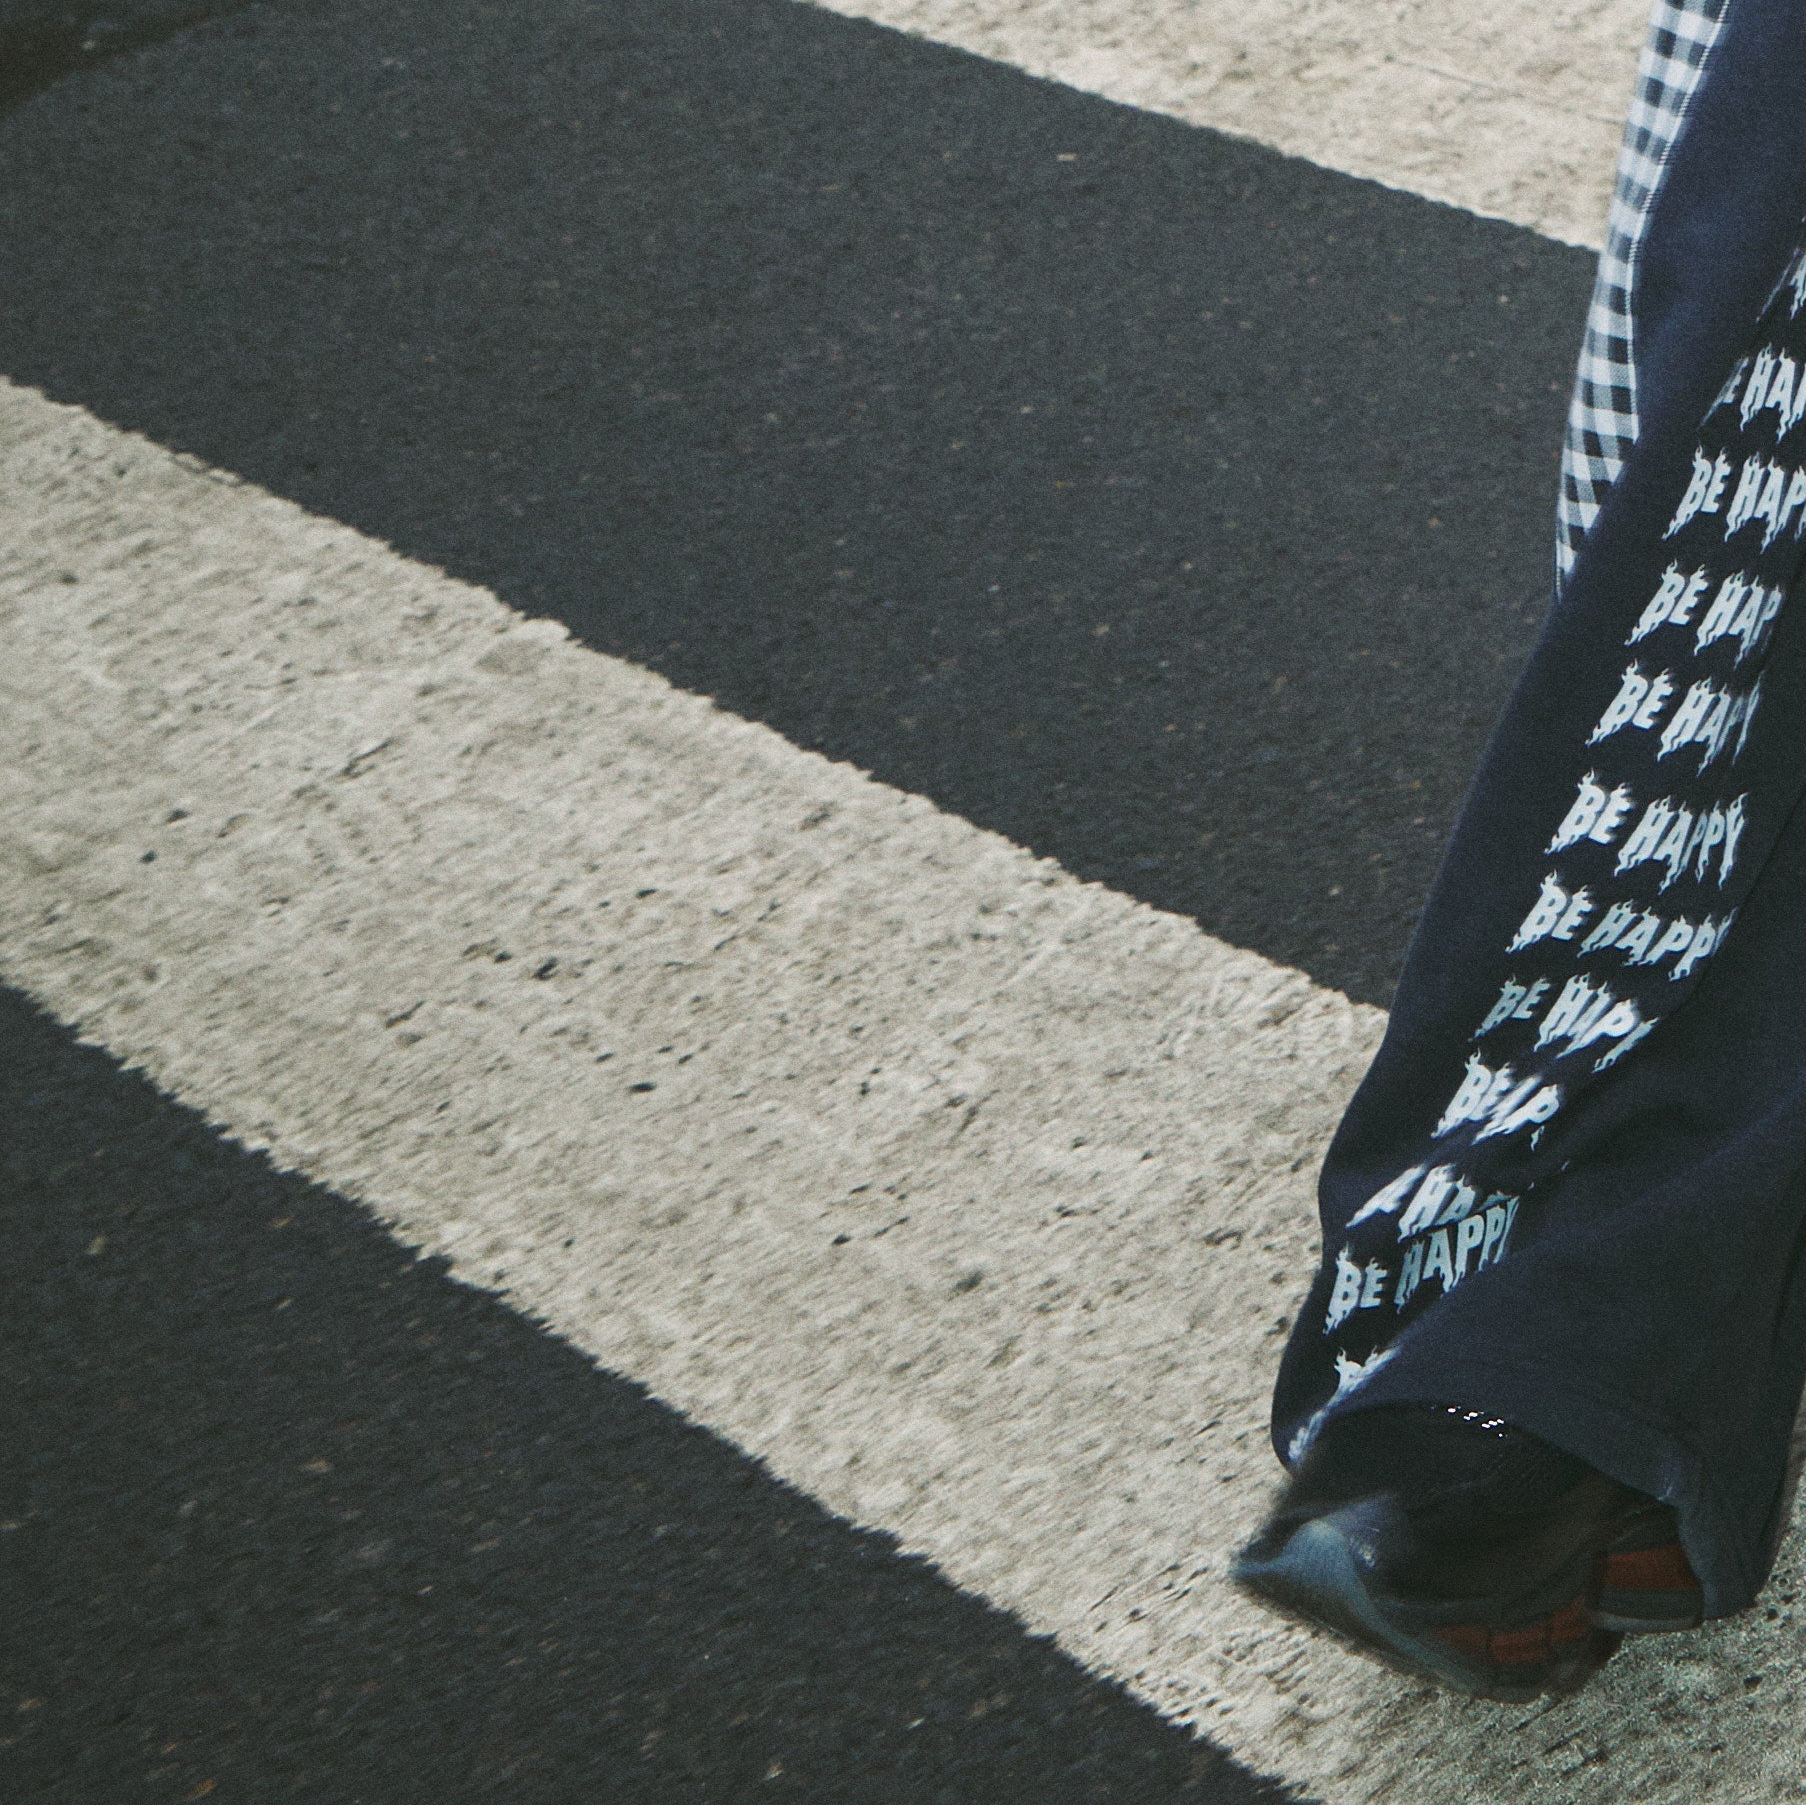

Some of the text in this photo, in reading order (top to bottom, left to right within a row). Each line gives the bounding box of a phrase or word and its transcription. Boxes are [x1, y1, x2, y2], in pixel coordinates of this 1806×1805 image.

[1661, 444, 1732, 541] BE
[1624, 558, 1784, 673] BE HAP
[1584, 657, 1674, 749] BE
[1543, 767, 1749, 896] BE HAPPY
[1505, 868, 1594, 955] BE
[1468, 972, 1551, 1042] BE
[1322, 1240, 1389, 1337] BE
